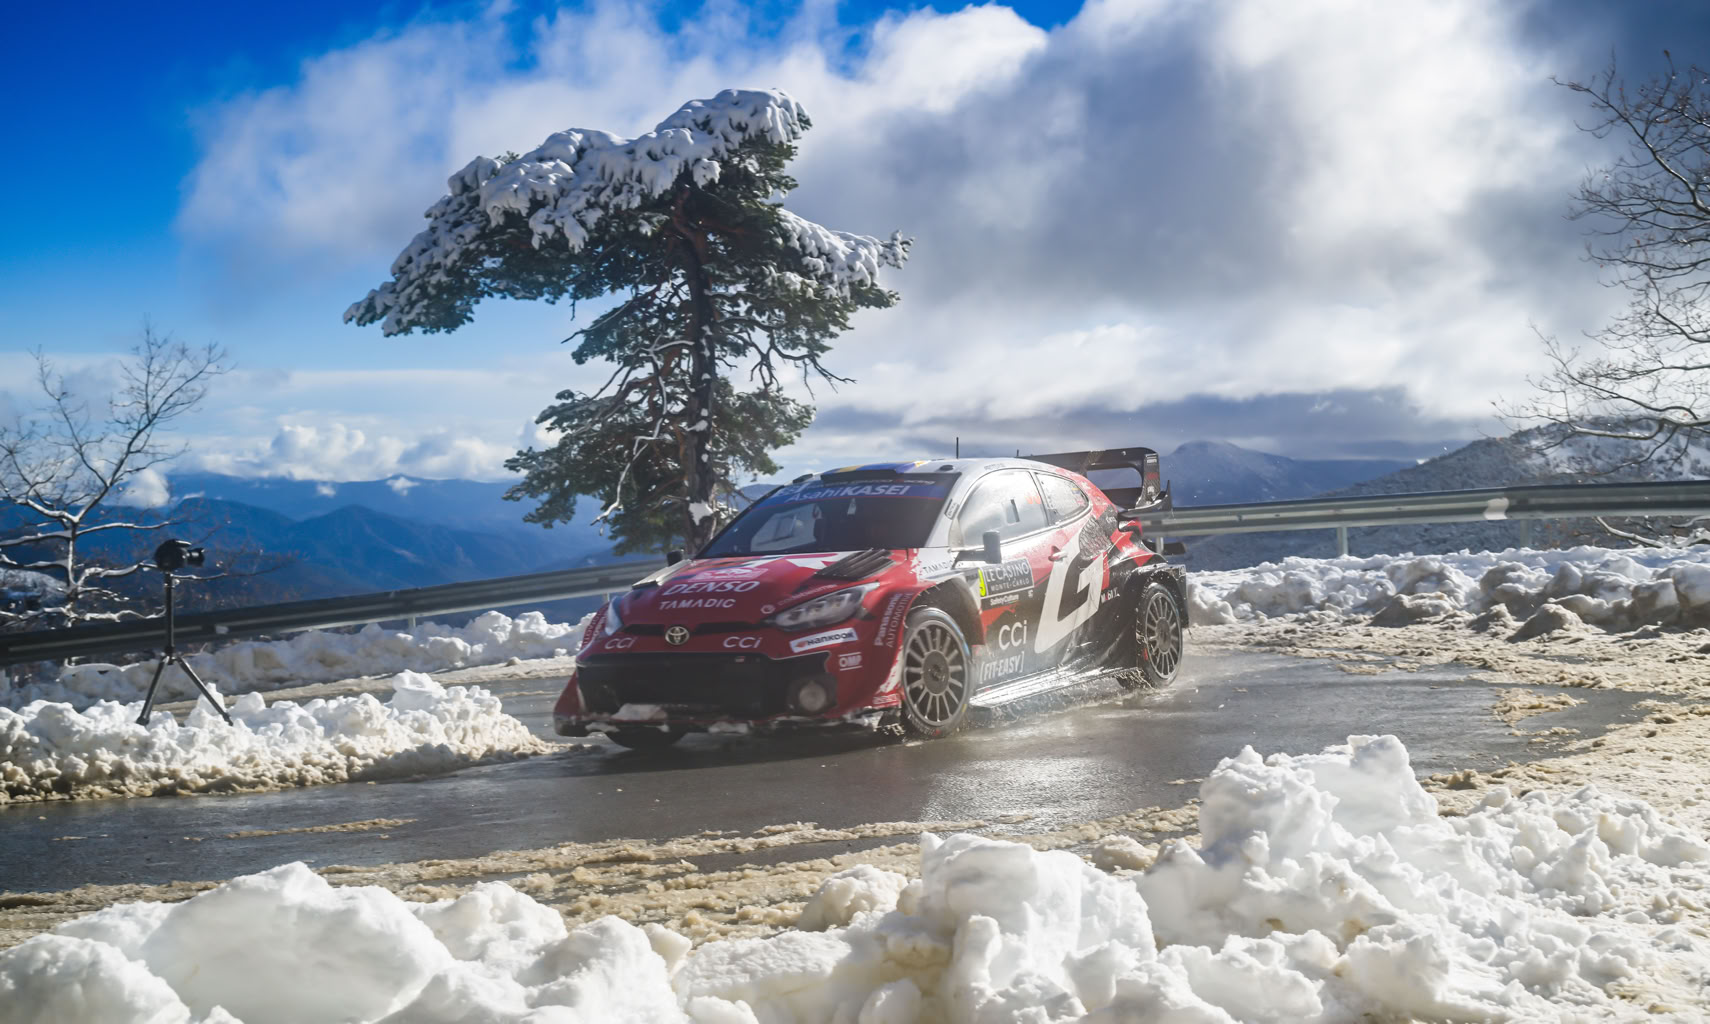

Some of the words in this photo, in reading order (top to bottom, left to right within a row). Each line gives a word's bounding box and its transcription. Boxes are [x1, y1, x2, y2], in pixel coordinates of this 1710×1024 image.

[662, 581, 760, 596] DENSO
[659, 599, 736, 611] TAMADIC
[723, 636, 763, 649] CCi
